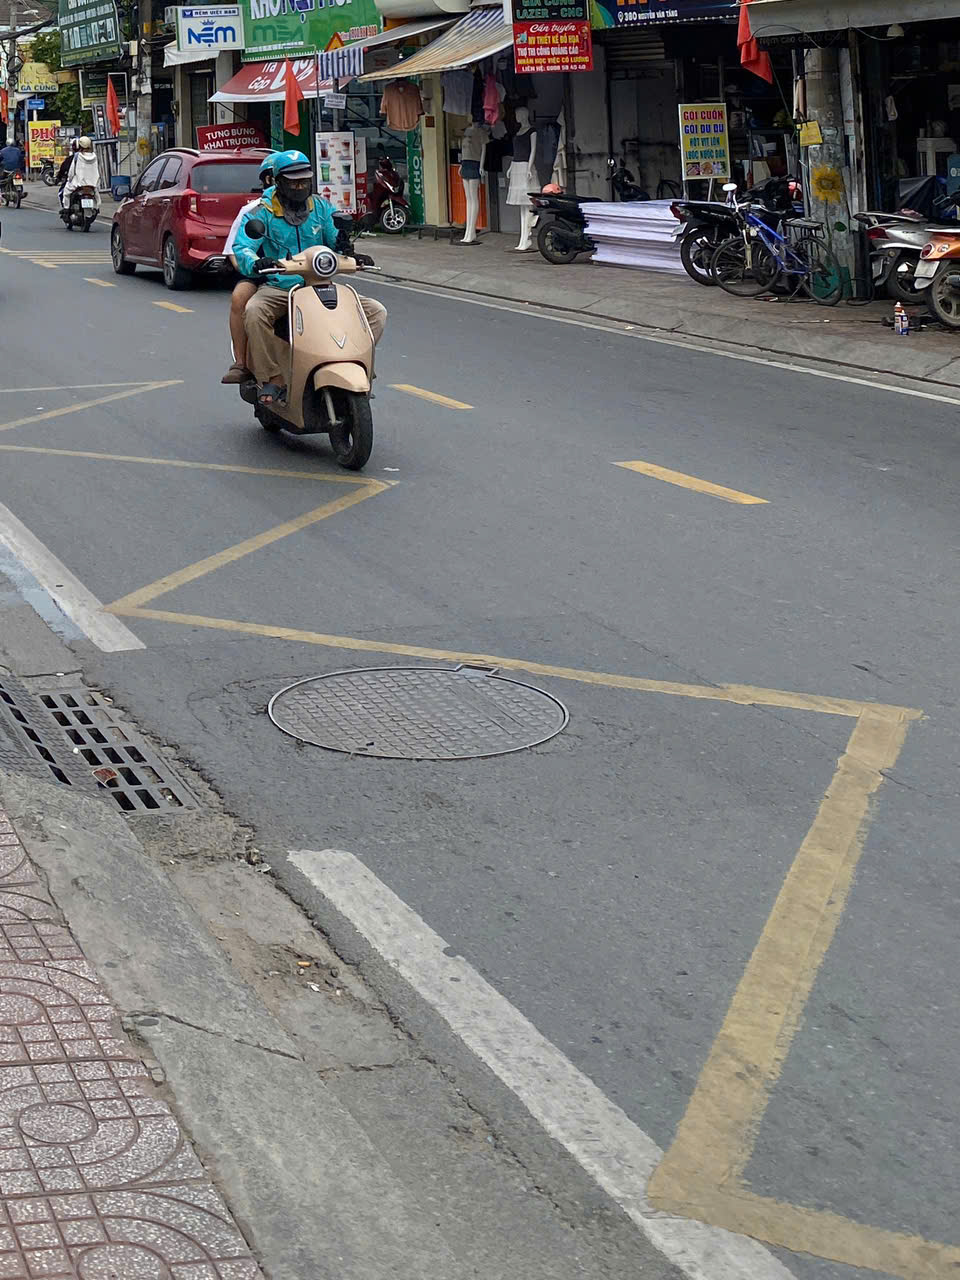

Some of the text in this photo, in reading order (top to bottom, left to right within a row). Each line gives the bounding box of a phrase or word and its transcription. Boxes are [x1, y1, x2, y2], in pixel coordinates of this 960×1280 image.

[516, 8, 584, 19] LAZER CNC
[203, 140, 224, 150] KHAI
[412, 156, 421, 195] KHO
